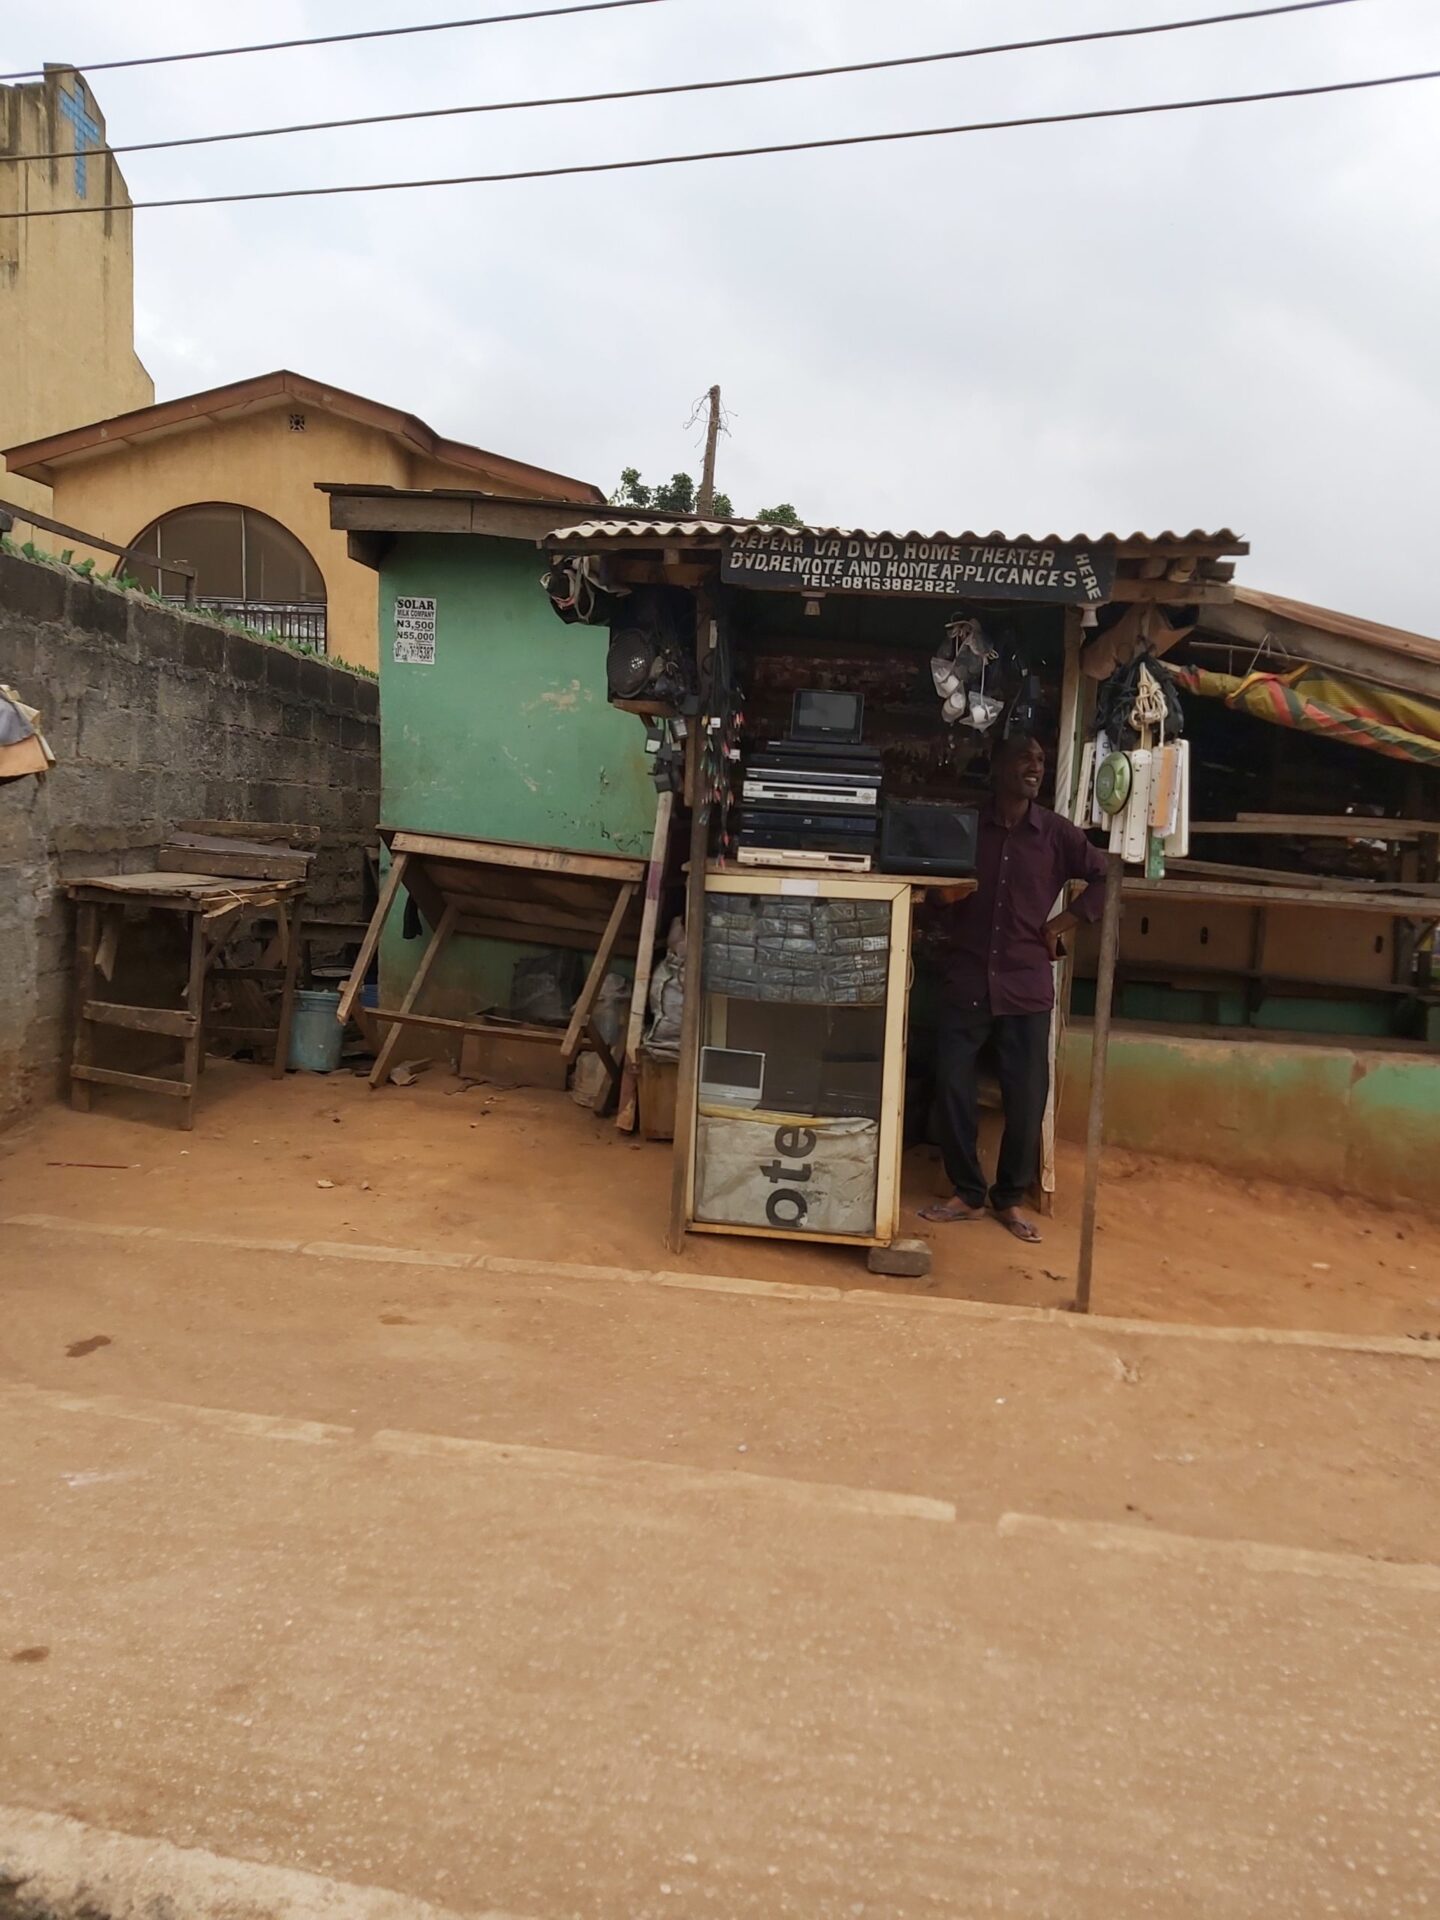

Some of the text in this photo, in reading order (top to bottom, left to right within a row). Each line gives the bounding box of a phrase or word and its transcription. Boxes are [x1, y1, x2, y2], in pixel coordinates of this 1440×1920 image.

[903, 543, 961, 562] HOME
[969, 546, 1056, 567] THEATER
[848, 560, 881, 577] AND
[1075, 553, 1102, 600] HERE
[397, 599, 434, 610] SOLAR
[410, 610, 434, 618] COMPANY
